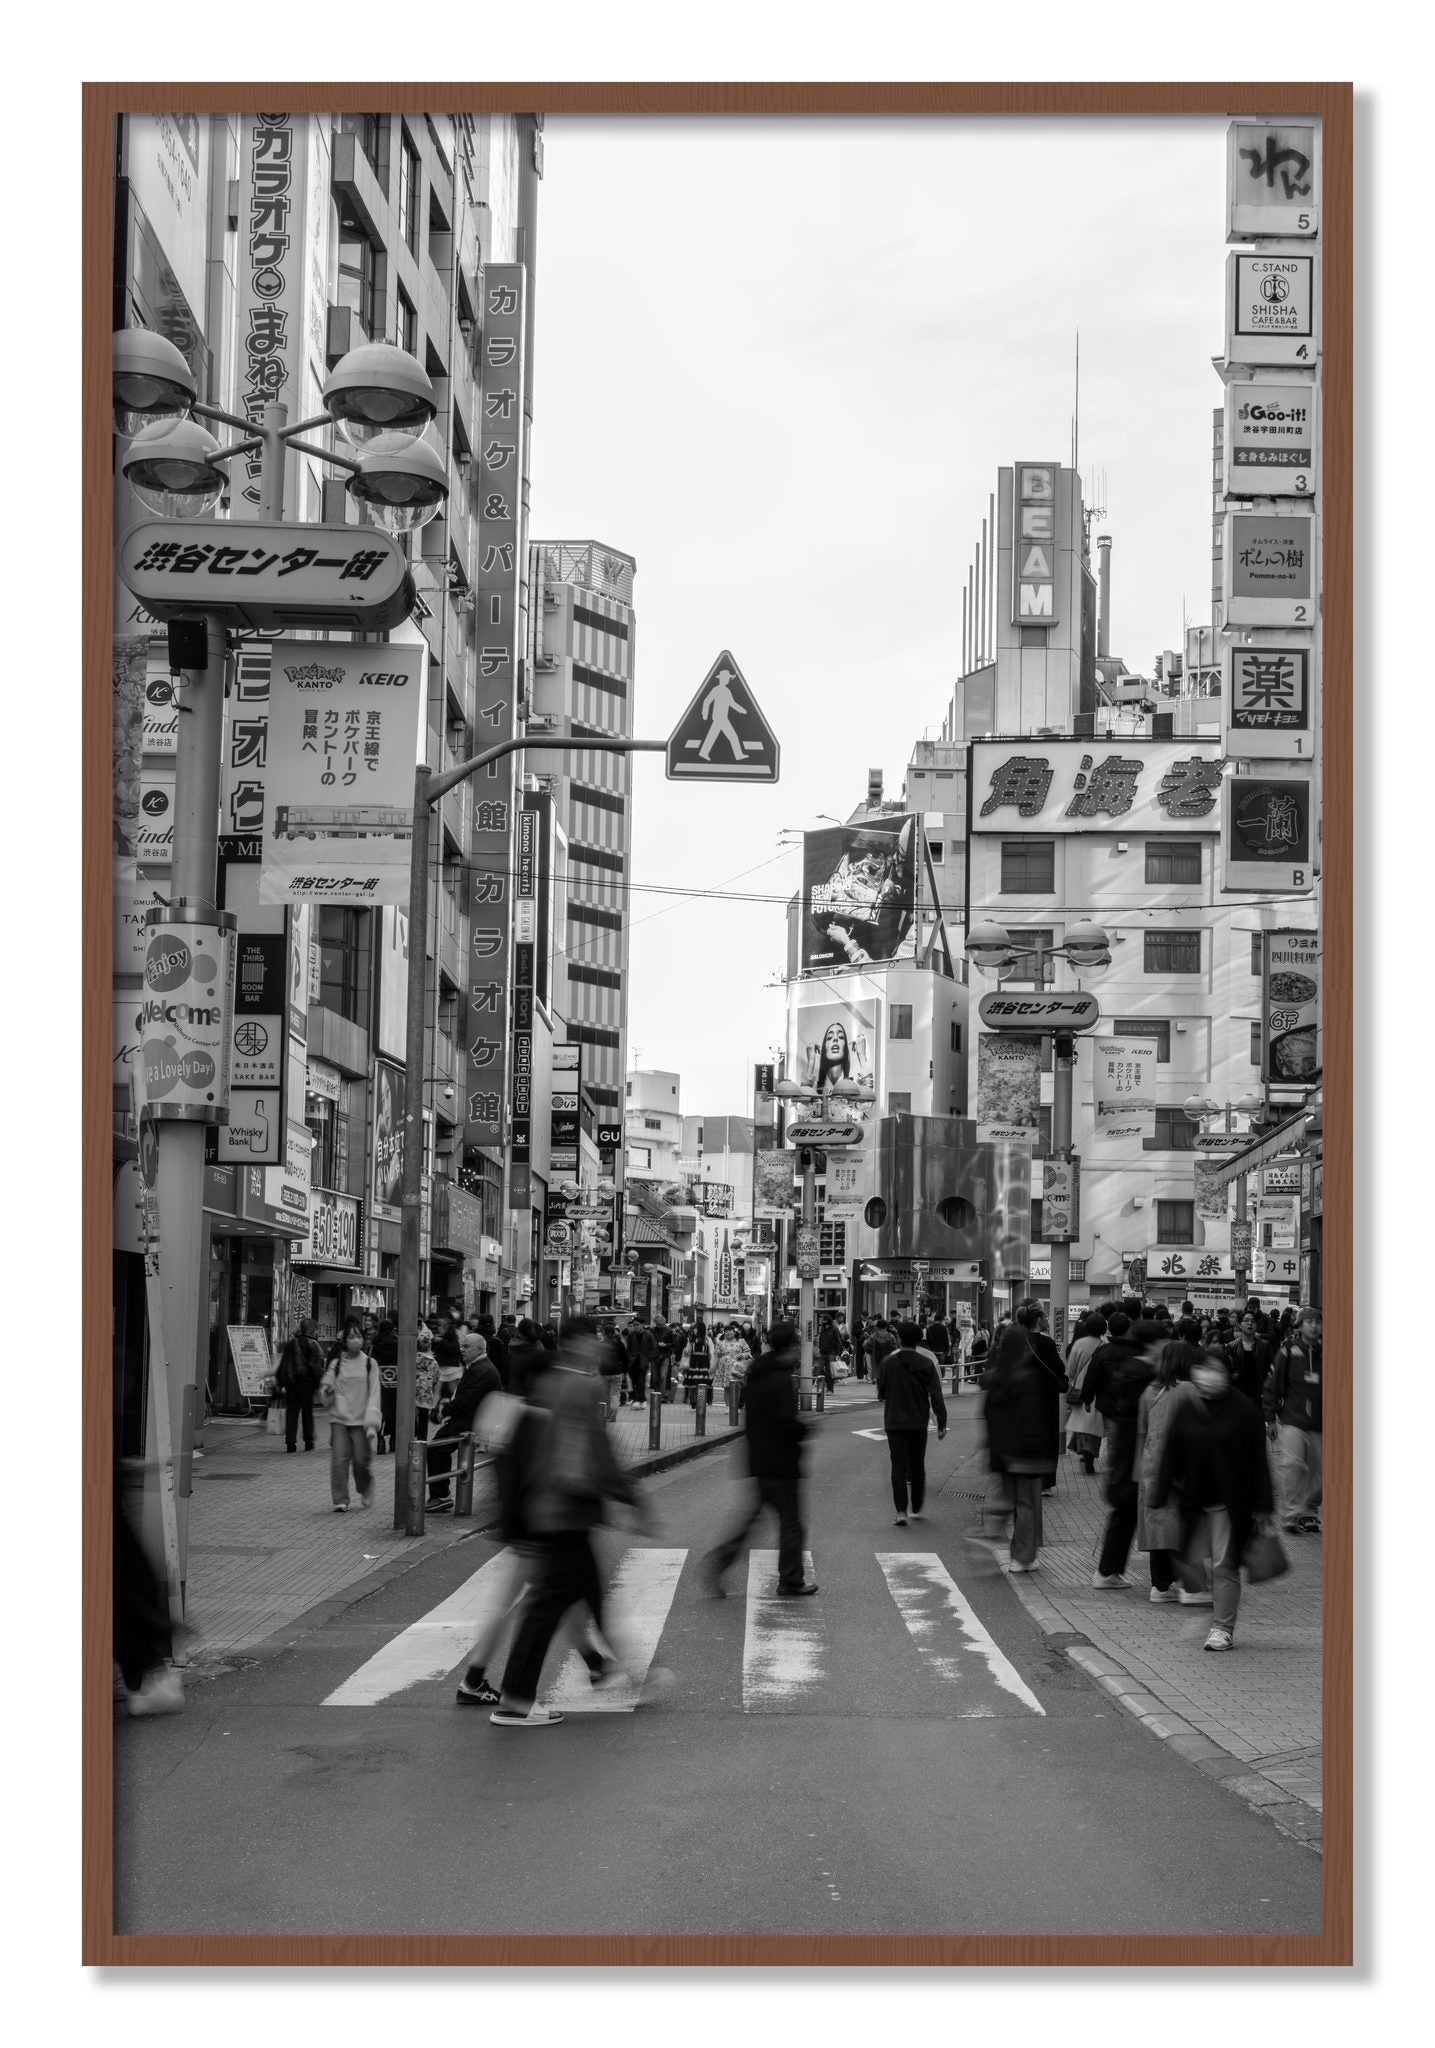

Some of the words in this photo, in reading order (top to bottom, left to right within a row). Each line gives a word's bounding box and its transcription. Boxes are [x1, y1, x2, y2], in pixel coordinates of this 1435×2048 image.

[249, 127, 293, 270] カラオケ
[1297, 214, 1310, 230] 5
[1251, 262, 1298, 273] C.STAND
[1251, 304, 1298, 316] SHISHA
[1251, 315, 1298, 325] CAFE&BAR
[1250, 404, 1306, 422] Goo-it!
[1243, 425, 1303, 435] 渋谷宇田川町店
[1238, 451, 1308, 464] 全身もみほぐし
[1295, 475, 1308, 492] 3
[1019, 467, 1053, 616] BEAM
[133, 541, 390, 581] 渋谷センター街
[1249, 572, 1296, 580] Pomme-no-ki
[1294, 605, 1307, 622] 2
[297, 681, 333, 689] KANTO
[358, 672, 409, 687] KEIO
[1242, 656, 1294, 708] 薬
[1236, 712, 1300, 726] マツモトキヨシ
[301, 709, 319, 753] 冒険へ
[147, 738, 172, 747] 渋谷店
[320, 709, 339, 786] カントーの
[341, 709, 361, 786] ポケパーク
[364, 710, 382, 772] 京王線で
[1294, 738, 1303, 754] 1
[1236, 794, 1299, 845] 一蘭
[523, 816, 531, 853] kimono
[521, 858, 530, 893] hearts
[1293, 869, 1305, 886] B
[288, 876, 381, 891] 渋谷センター街
[811, 882, 851, 896] SHAPING
[242, 954, 265, 962] THIRD
[246, 947, 261, 955] THE
[810, 952, 834, 960] SALOMON
[1271, 951, 1316, 962] 四川料理
[147, 947, 189, 985] Enjoy
[241, 983, 264, 991] ROOM
[244, 993, 260, 1002] BAR
[468, 873, 505, 1124] カラオケ館
[143, 1000, 222, 1026] Welcome
[986, 1000, 1093, 1015] 渋谷センター街
[1269, 1011, 1300, 1031] 6F
[173, 1022, 192, 1042] Shibuya
[160, 1059, 191, 1081] Lovely
[193, 1061, 214, 1076] Day!
[234, 1073, 255, 1081] SAKE
[259, 1073, 276, 1081] BAR
[1115, 1062, 1123, 1092] カントーの
[563, 1101, 577, 1110] UP
[229, 1128, 264, 1138] Whisky
[599, 1130, 620, 1142] GU
[789, 1127, 855, 1137] 渋谷センター街
[228, 1137, 250, 1146] Bank
[1196, 1137, 1256, 1146] 渋谷センター街
[1161, 1253, 1223, 1276] 兆楽
[720, 1252, 731, 1296] BEER
[718, 1297, 731, 1305] HALL
